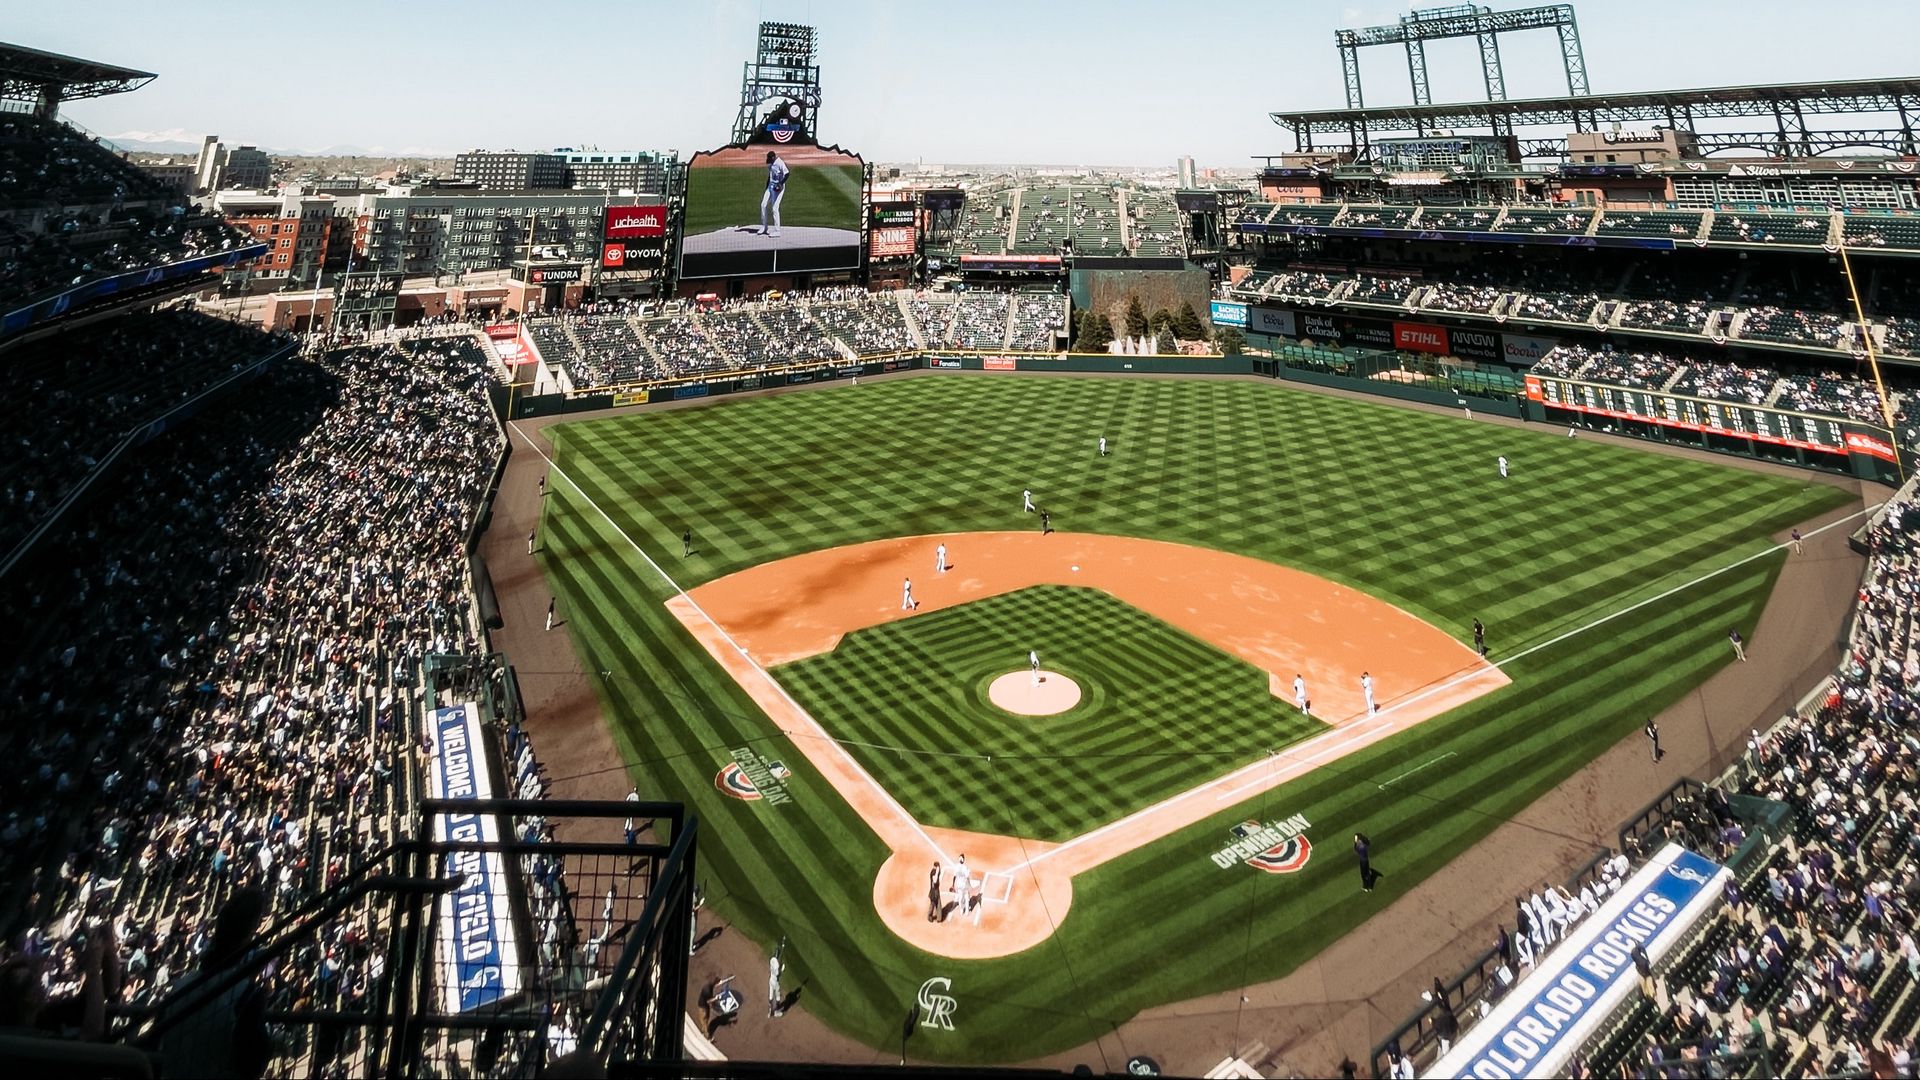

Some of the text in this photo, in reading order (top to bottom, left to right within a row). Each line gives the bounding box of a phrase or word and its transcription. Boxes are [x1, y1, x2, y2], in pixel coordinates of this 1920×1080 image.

[1746, 165, 1781, 176] Silver
[614, 214, 658, 228] uchealth
[624, 249, 662, 258] TOYOTA
[542, 270, 579, 280] TUNDRA
[1263, 313, 1285, 326] Coors
[1304, 315, 1333, 328] Bank of
[1305, 325, 1341, 338] Colorado
[1400, 330, 1441, 346] STIHL
[730, 746, 793, 806] OPENING DAY
[442, 724, 473, 800] WELCOME
[458, 890, 493, 961] FIELD
[1210, 812, 1312, 870] OPENING DAY
[1460, 892, 1677, 1080] OLORADO ROCKIES
